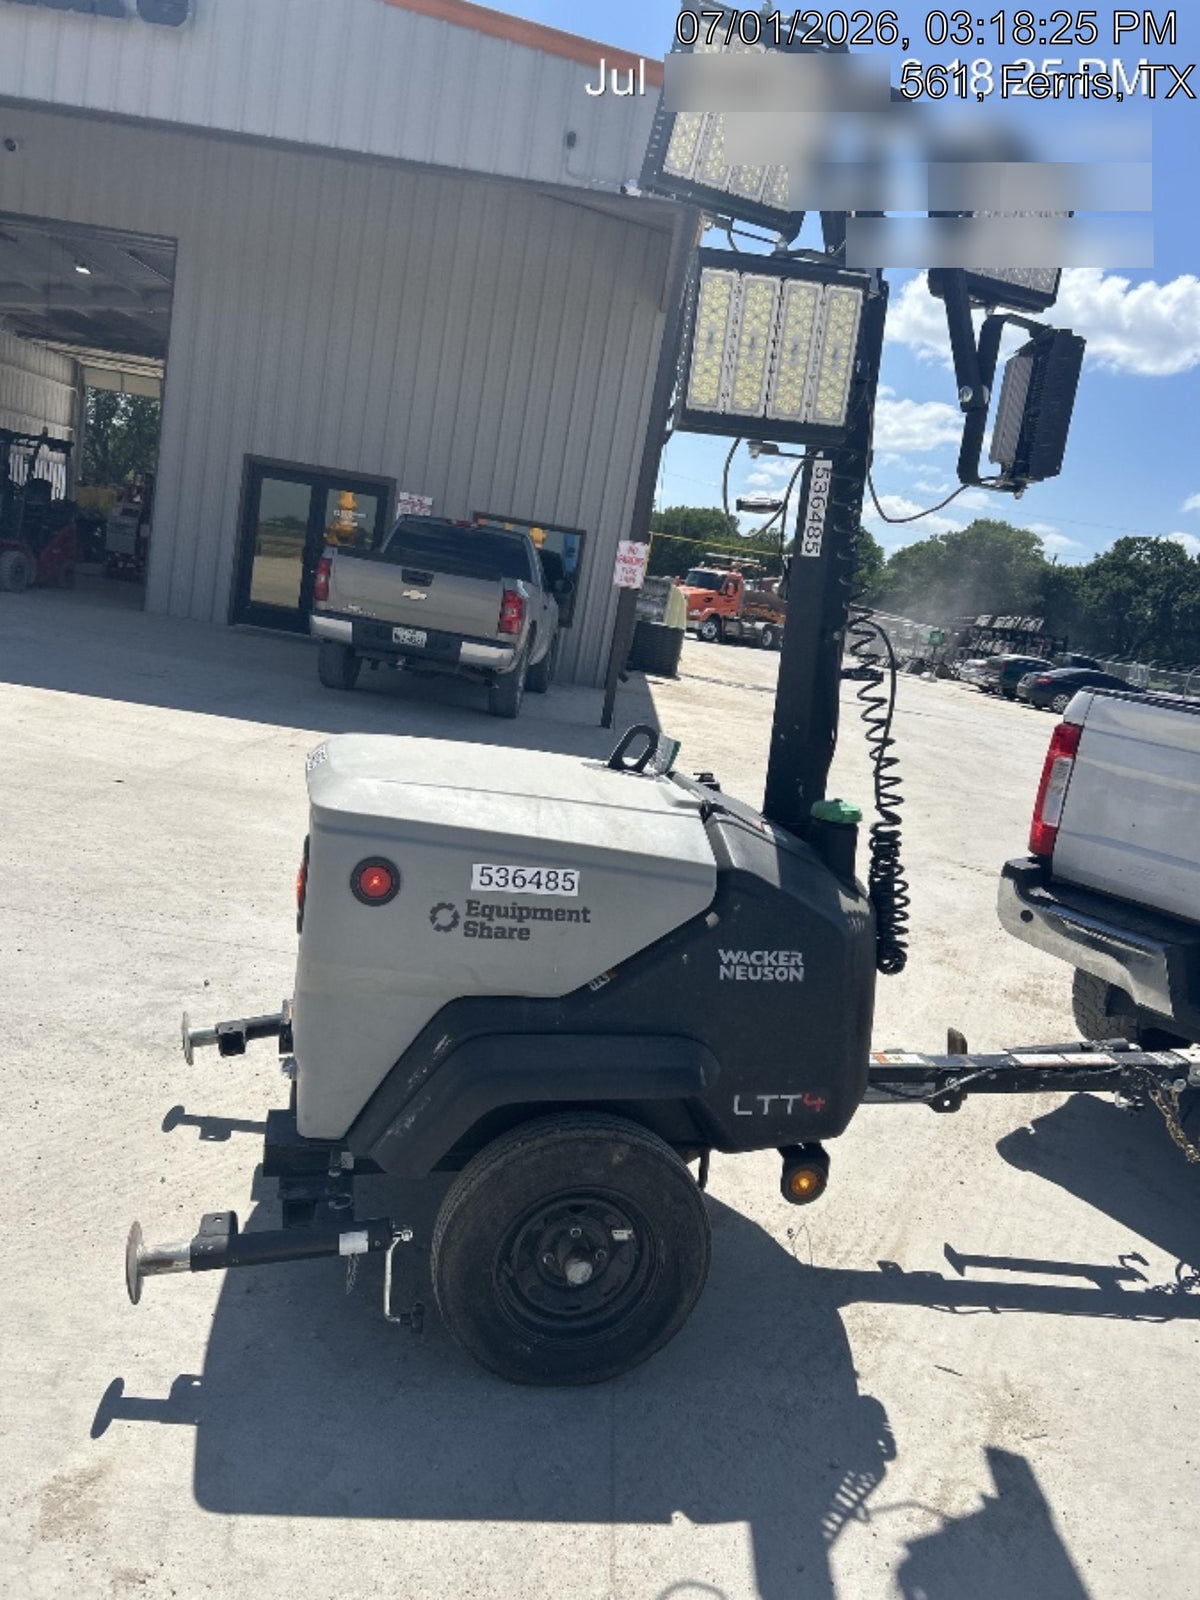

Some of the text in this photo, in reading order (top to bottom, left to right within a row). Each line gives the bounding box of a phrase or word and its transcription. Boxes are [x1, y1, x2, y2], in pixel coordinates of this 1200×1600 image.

[804, 466, 831, 553] 536485
[479, 866, 576, 892] 536485
[465, 899, 592, 924] Equipment
[463, 920, 532, 941] Share
[718, 948, 805, 966] WACKER
[719, 965, 805, 982] NEUSON
[733, 1093, 826, 1116] LTT4
